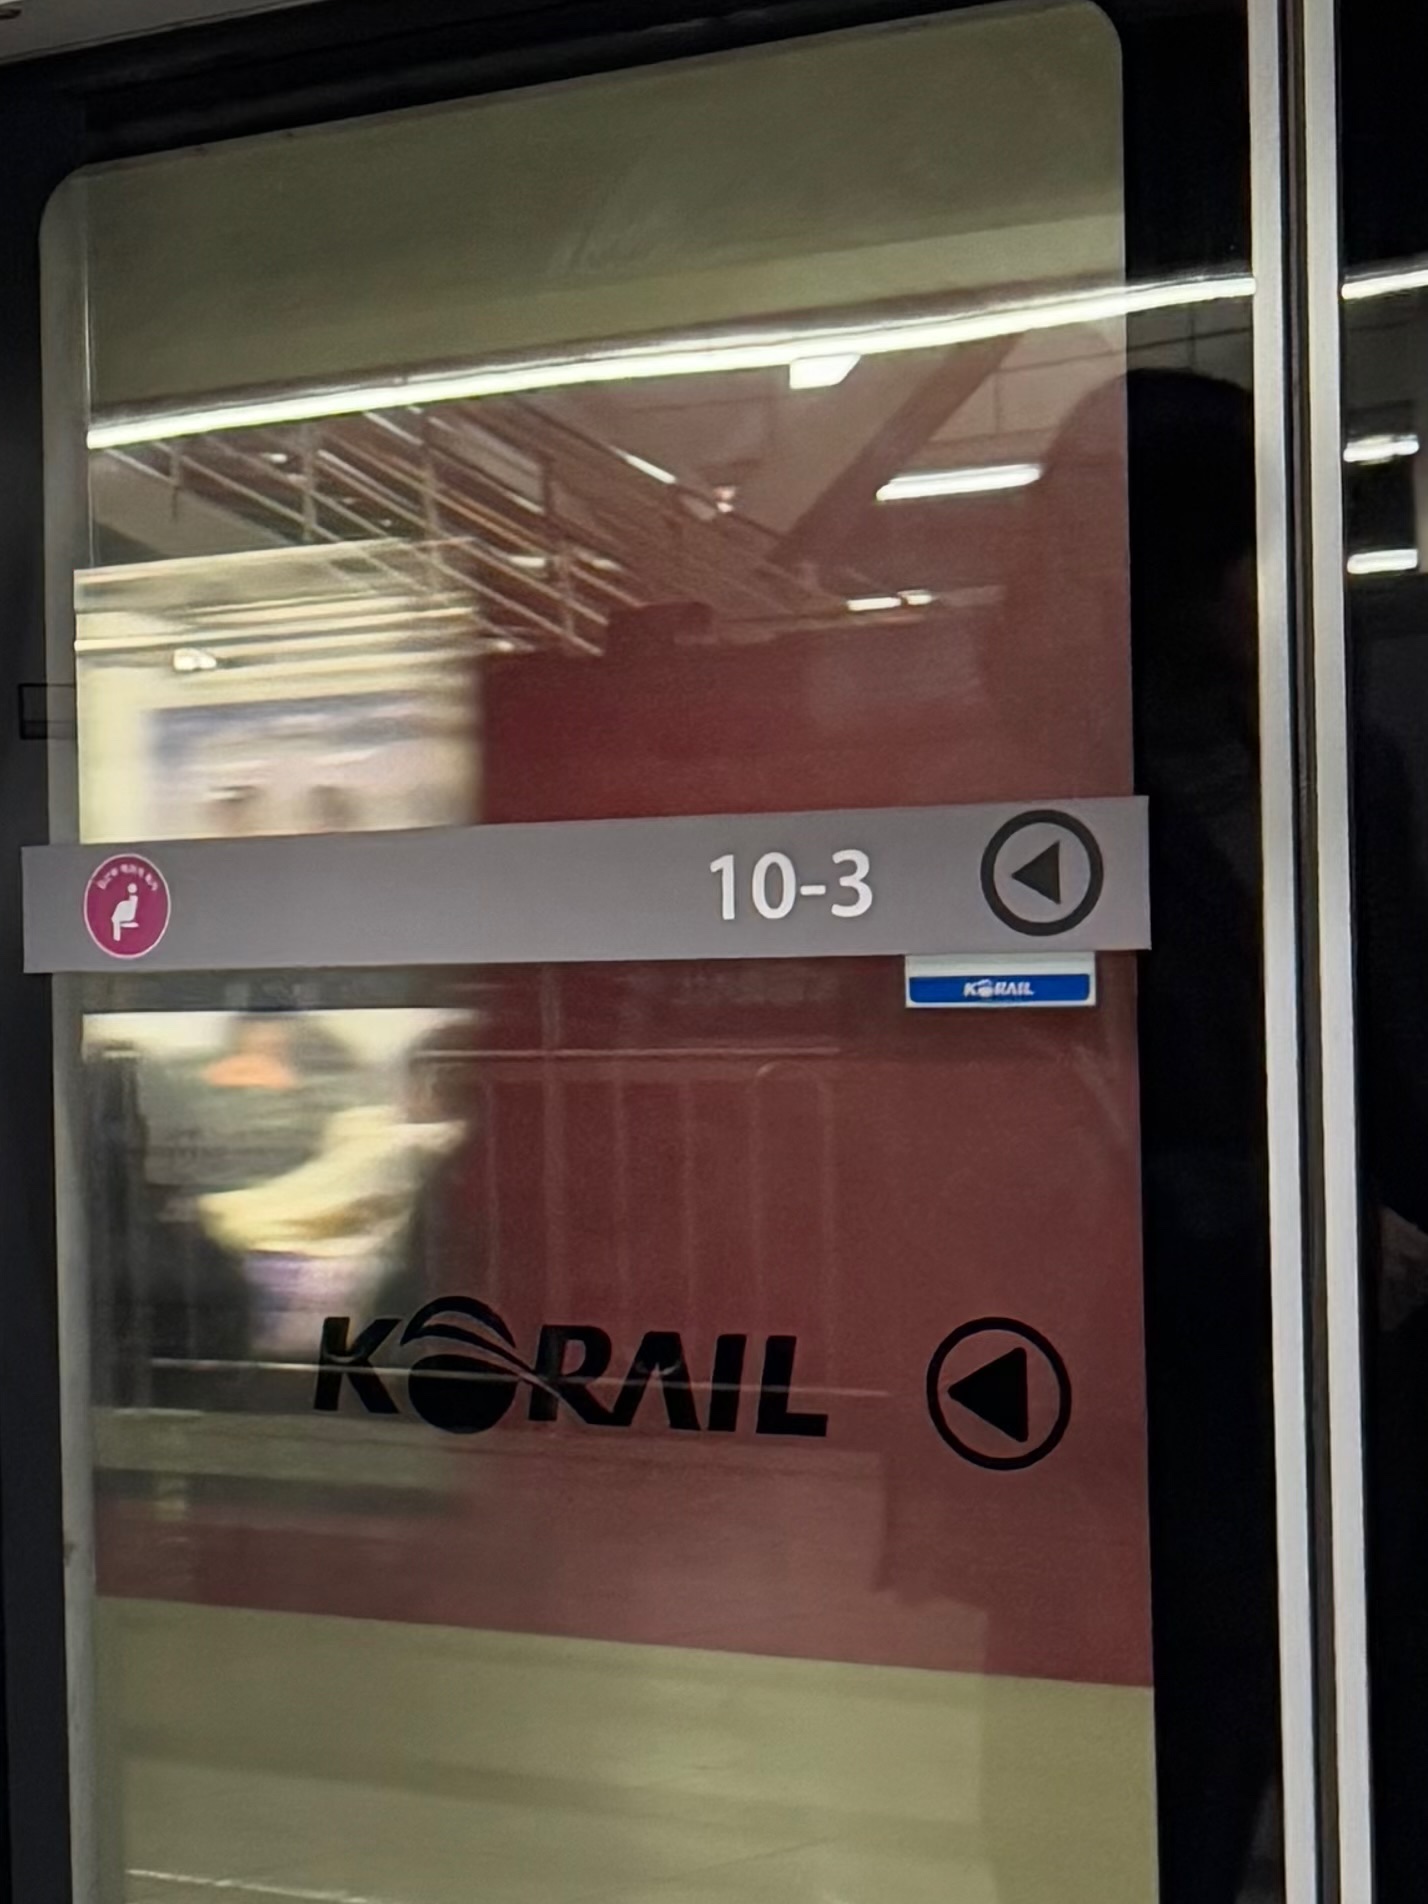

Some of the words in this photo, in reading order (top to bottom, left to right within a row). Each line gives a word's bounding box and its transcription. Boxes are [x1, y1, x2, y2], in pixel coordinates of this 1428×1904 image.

[709, 848, 874, 921] 10-3
[963, 978, 1035, 998] KORAIL
[313, 1296, 828, 1436] KORAIL
